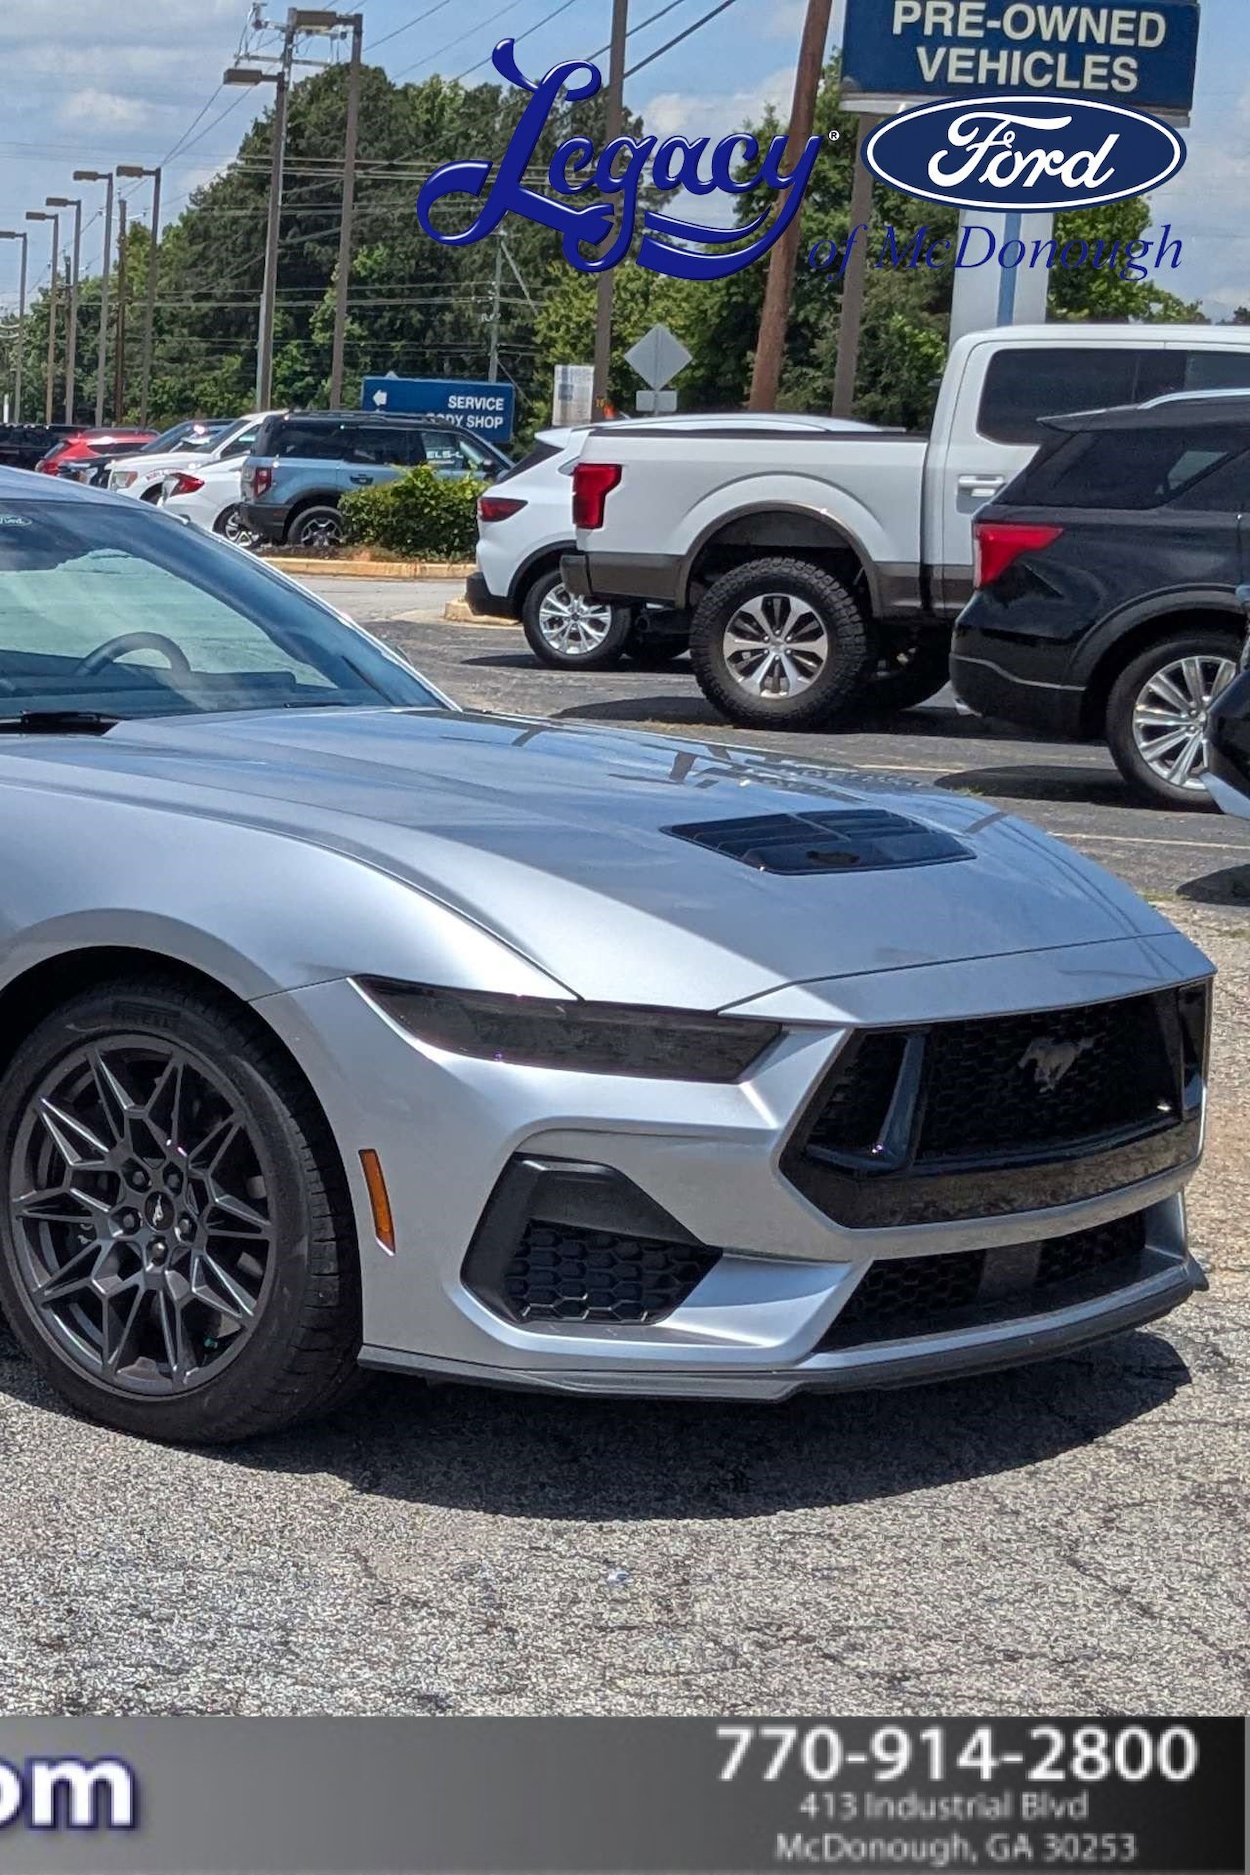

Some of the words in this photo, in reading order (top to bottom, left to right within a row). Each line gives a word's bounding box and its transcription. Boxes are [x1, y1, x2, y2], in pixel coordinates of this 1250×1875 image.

[892, 0, 1167, 49] PRE-OWNED
[916, 46, 1139, 93] VEHICLES
[447, 395, 505, 412] SERVICE
[466, 414, 504, 429] SHOP
